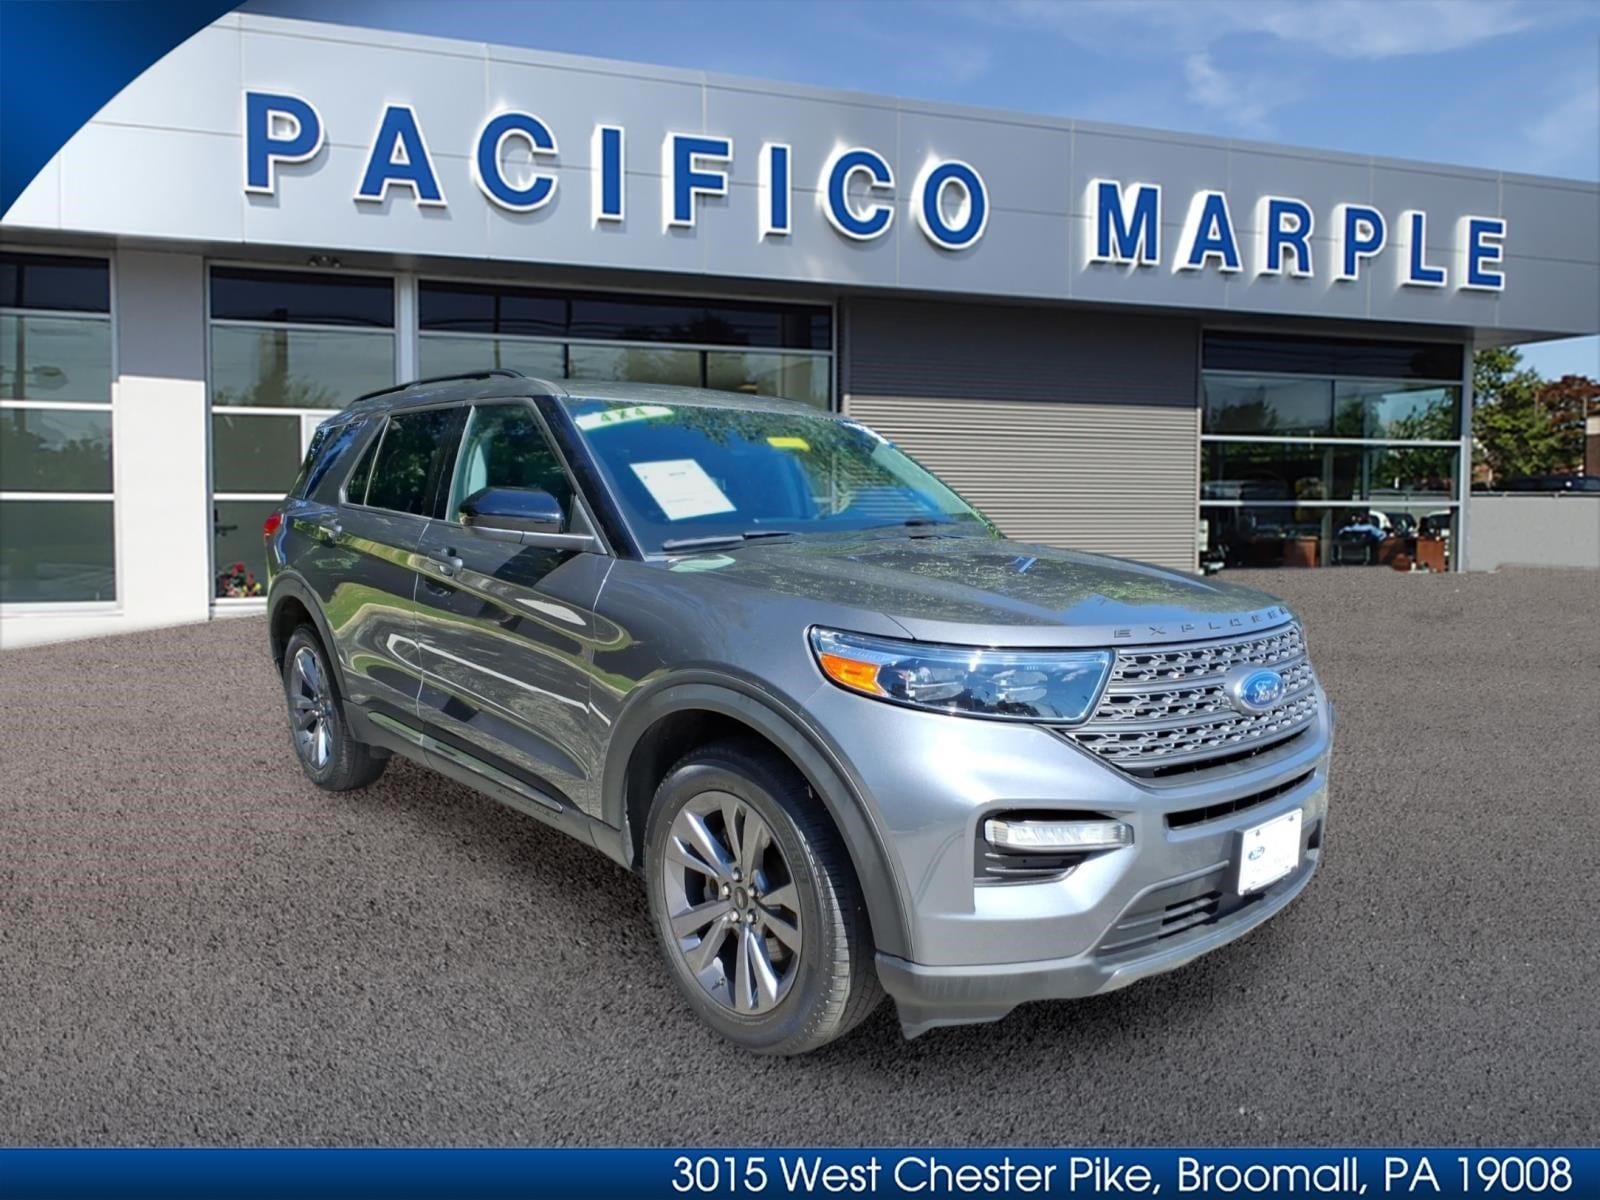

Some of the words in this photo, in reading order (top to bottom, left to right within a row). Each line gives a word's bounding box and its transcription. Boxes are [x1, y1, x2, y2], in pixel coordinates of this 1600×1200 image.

[244, 90, 989, 249] PACIFICO
[1090, 180, 1506, 291] MARPLE
[1113, 606, 1289, 639] EXPLORER
